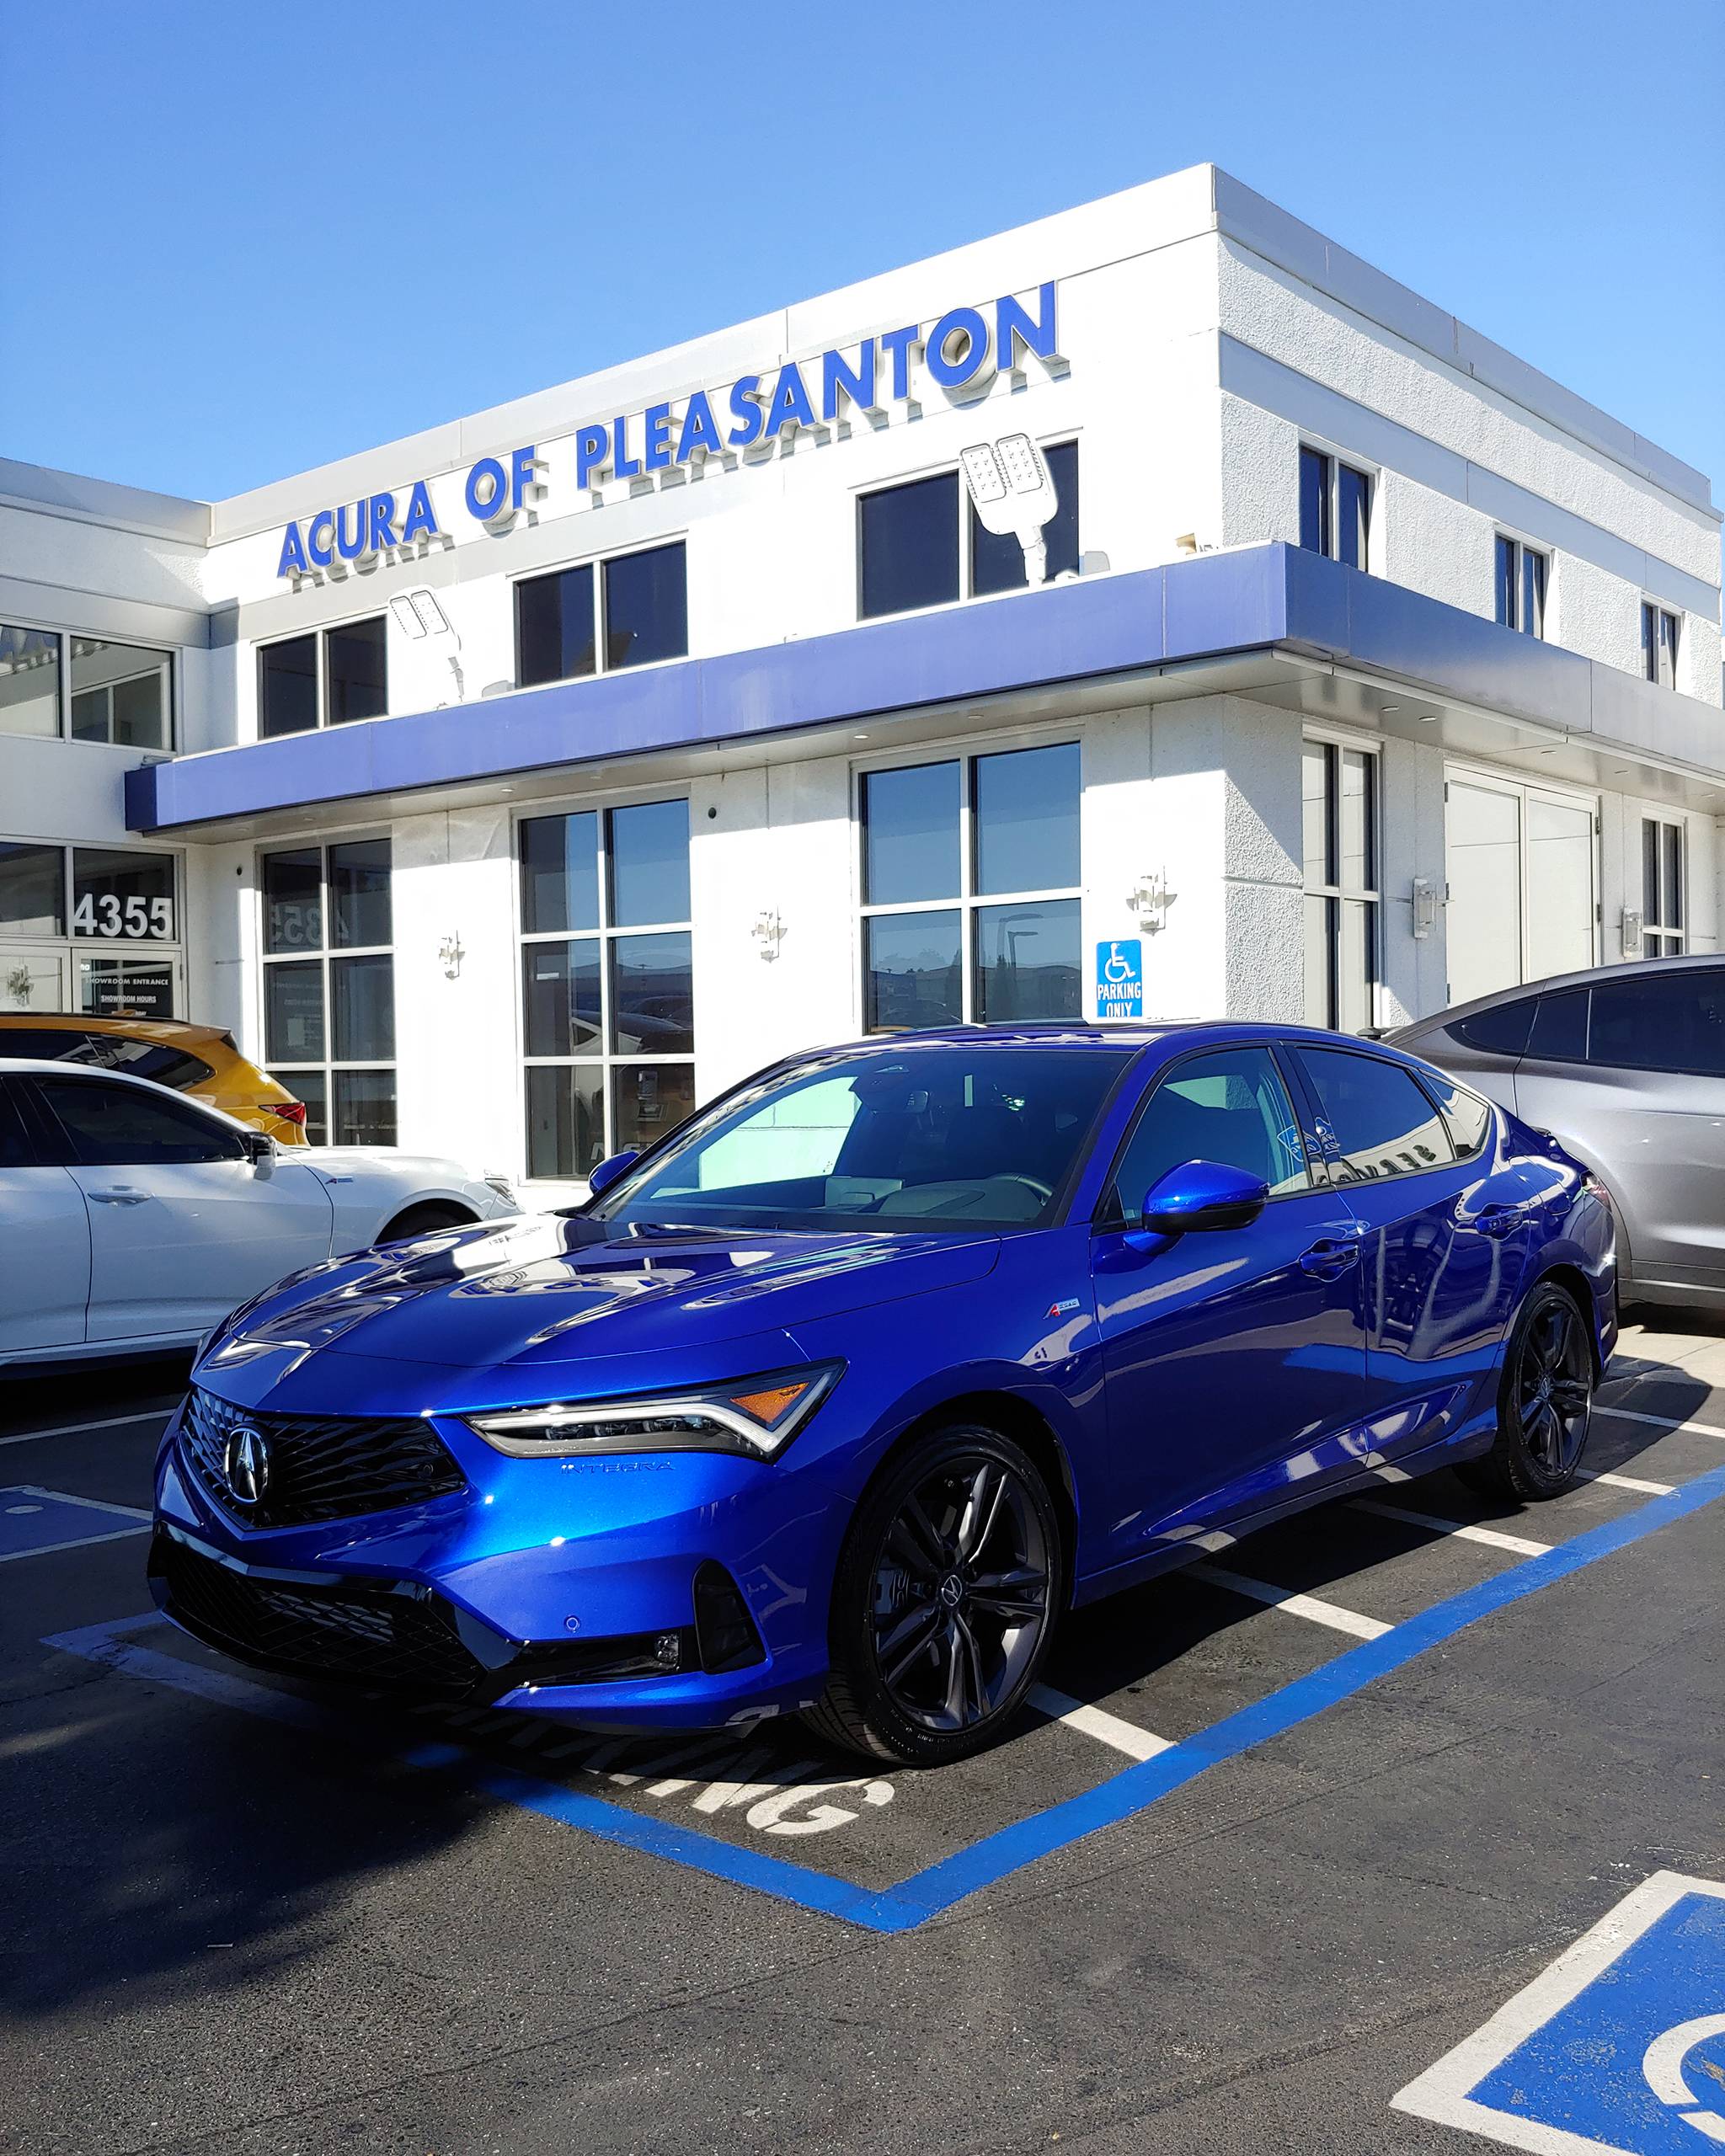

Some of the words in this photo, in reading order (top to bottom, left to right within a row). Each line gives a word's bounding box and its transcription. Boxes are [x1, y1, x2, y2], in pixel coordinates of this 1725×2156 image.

[277, 480, 438, 579] ACURA
[465, 445, 537, 521] OF
[575, 280, 1058, 491] PLEASANTON
[74, 894, 173, 939] 4355
[1097, 982, 1141, 1000] PARKING
[1106, 1002, 1133, 1017] ONLY
[560, 1462, 674, 1474] INTEGRA
